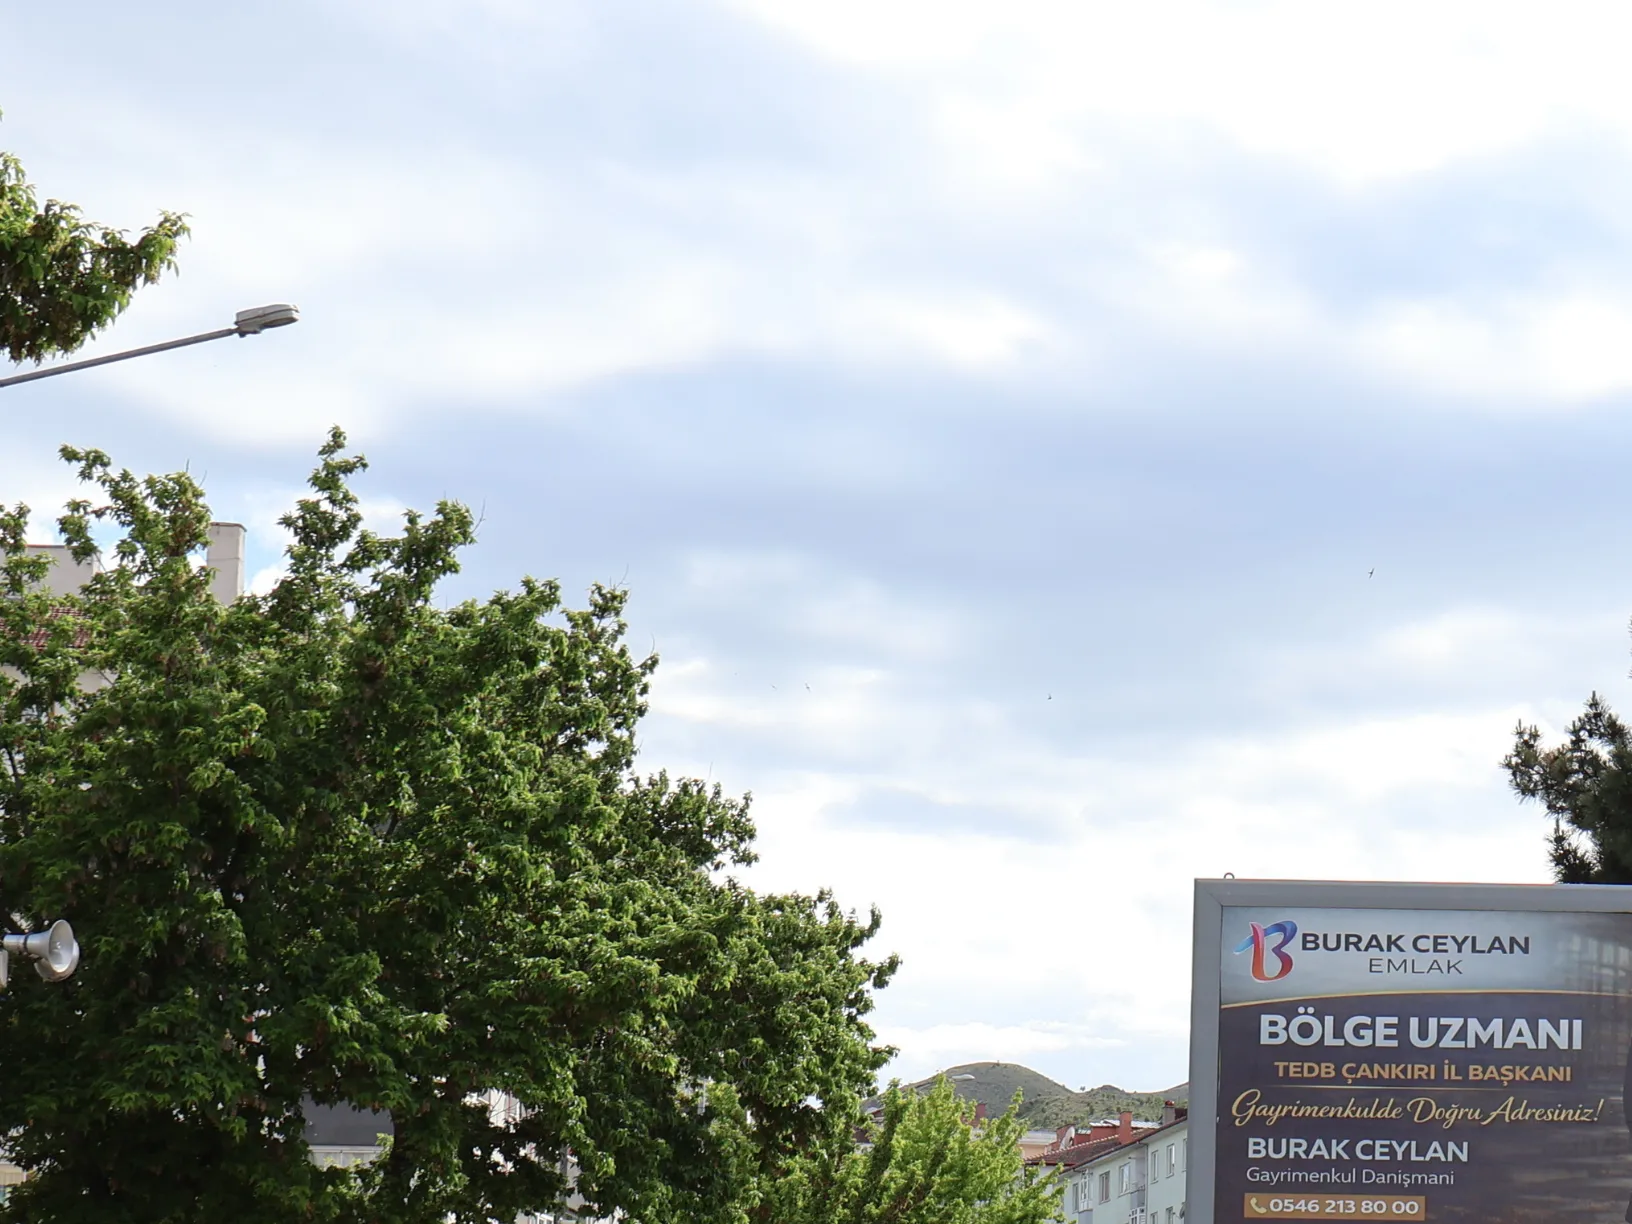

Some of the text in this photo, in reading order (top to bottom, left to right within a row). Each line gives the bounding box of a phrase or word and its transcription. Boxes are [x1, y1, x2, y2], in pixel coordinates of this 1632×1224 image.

[1301, 932, 1530, 955] BURAK CEYLAN
[1368, 957, 1464, 975] EMLAK
[1259, 1006, 1583, 1050] BÖLGE UZMANI
[1274, 1059, 1572, 1086] TEDB ÇANKIRI İL BAŞKANI
[1231, 1088, 1605, 1129] Gayrimenkulde Doğru Adresiniz!
[1247, 1137, 1468, 1162] BURAK CEYLAN
[1246, 1166, 1455, 1188] Gayrimenkul Danişmani
[1269, 1198, 1420, 1215] 0546 213 80 00
